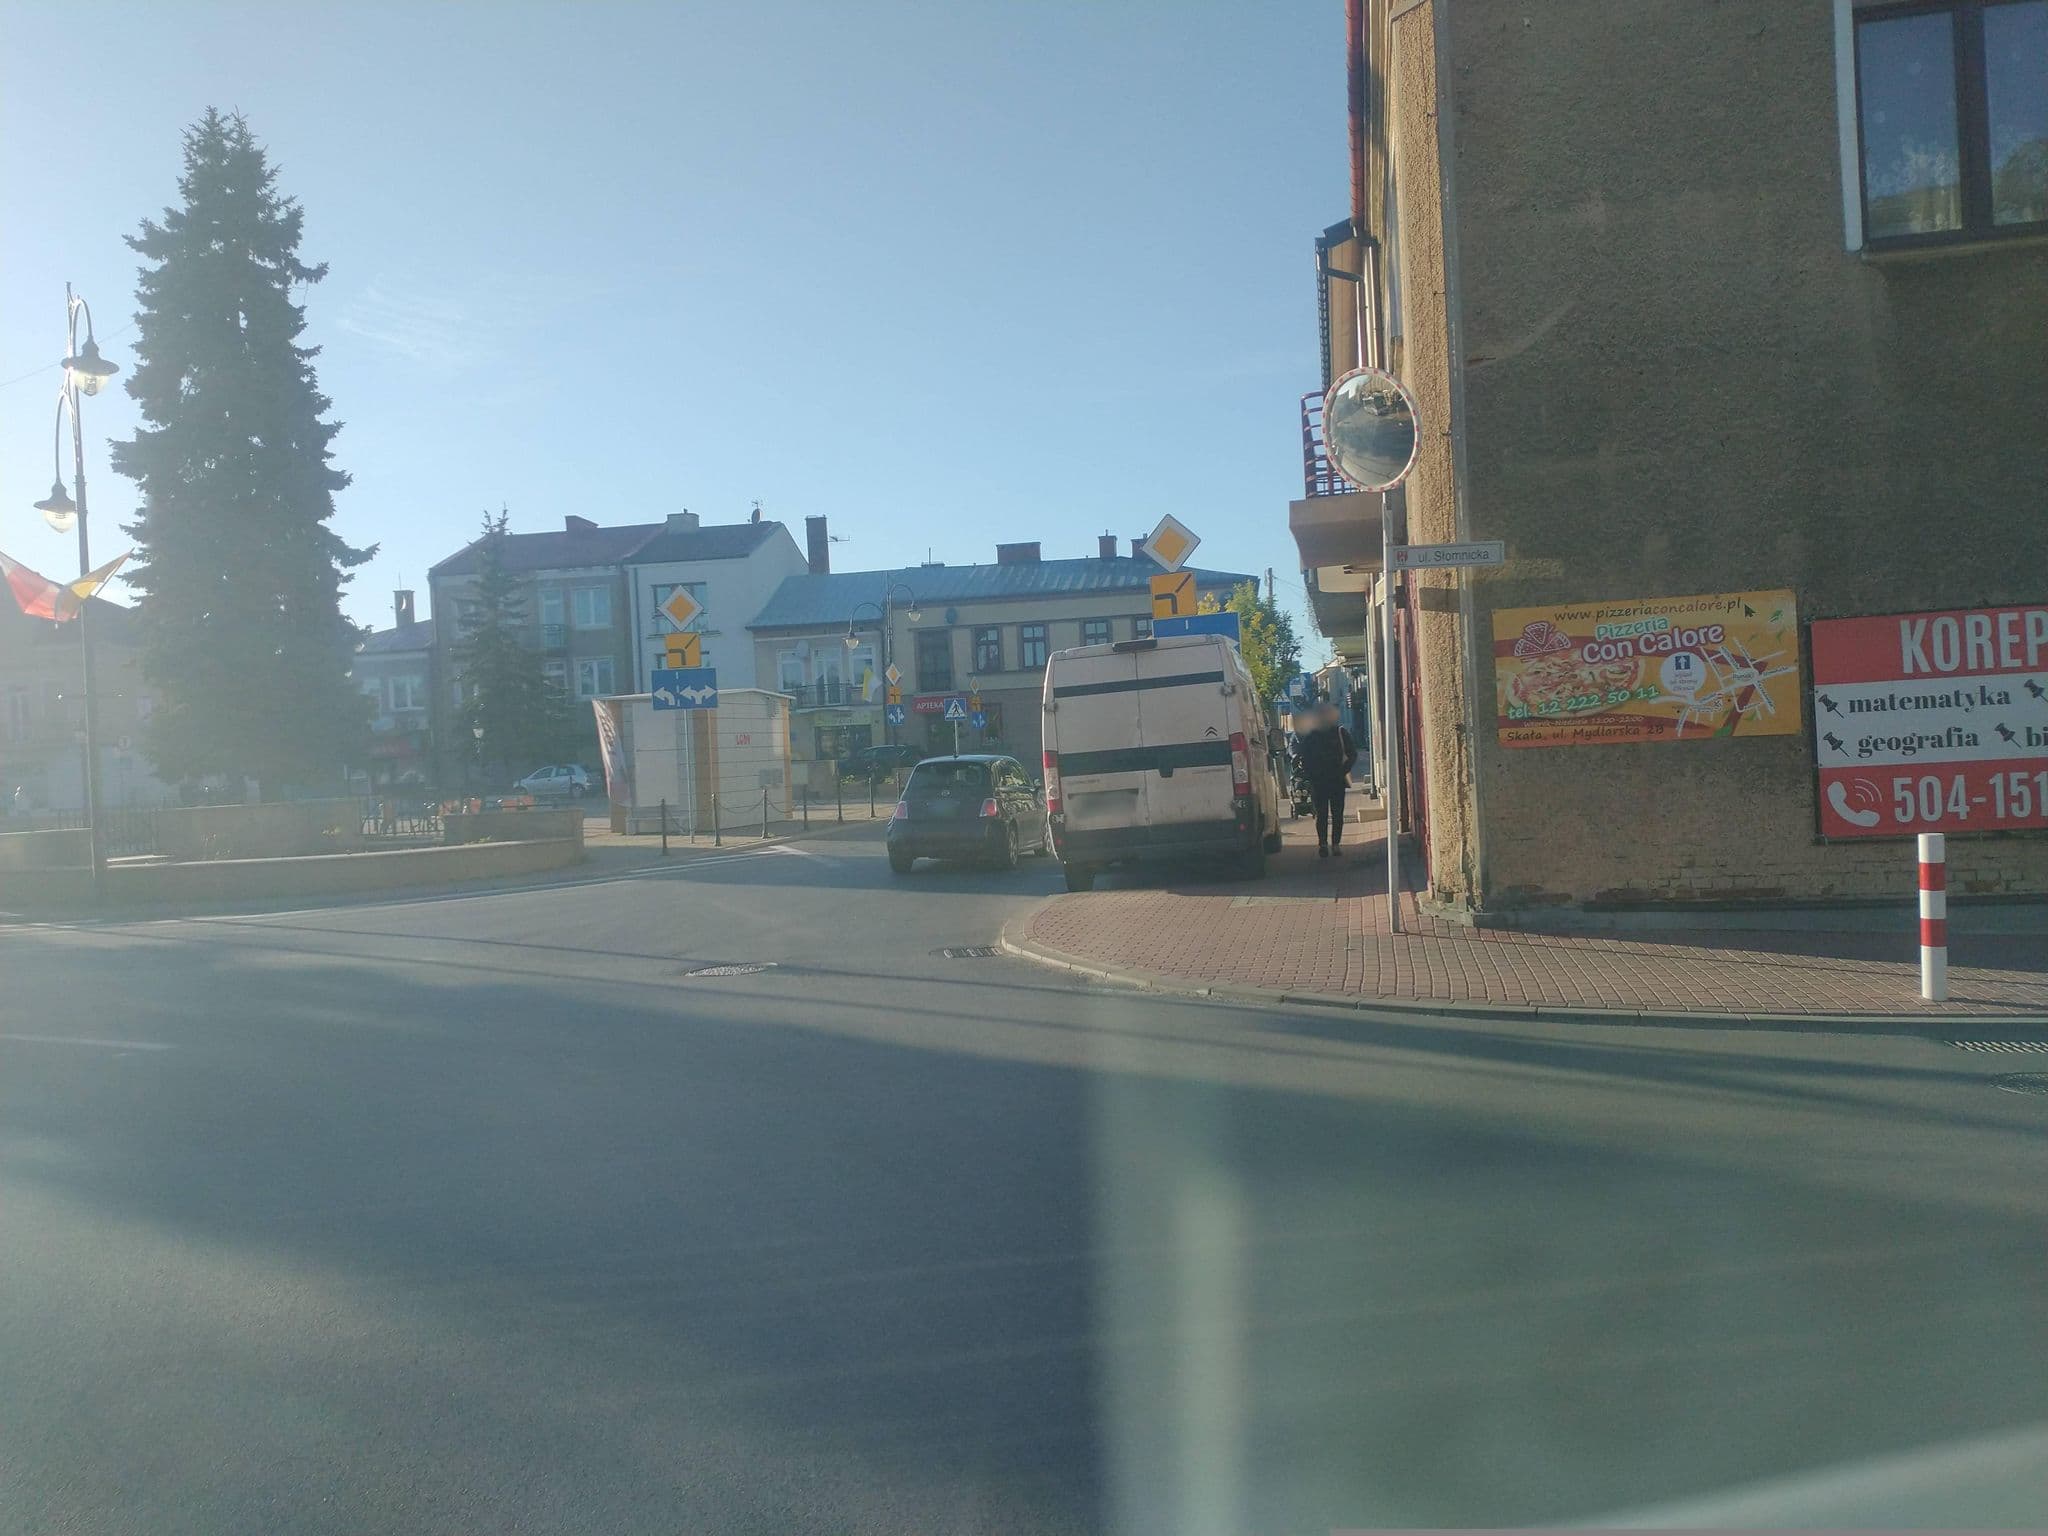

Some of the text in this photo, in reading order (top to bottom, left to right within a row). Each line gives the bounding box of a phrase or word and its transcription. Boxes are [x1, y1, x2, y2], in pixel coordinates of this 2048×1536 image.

[1417, 549, 1489, 563] ul. Słomnicka
[1554, 597, 1741, 622] www.pizzeriaconcalore.pl
[1597, 616, 1669, 640] Pizzeria
[1900, 610, 2048, 674] KOREP
[1583, 624, 1725, 663] Con Calore
[916, 701, 944, 710] APTEKA
[1508, 704, 1532, 719] tel.
[1538, 700, 1561, 714] 12
[1567, 694, 1600, 711] 222
[1608, 690, 1630, 704] 50
[1637, 685, 1660, 699] 11
[1849, 685, 2012, 713] matematyka
[1553, 728, 1567, 740] ul.
[1858, 727, 1980, 758] geografia
[1893, 771, 2048, 823] 504-151
